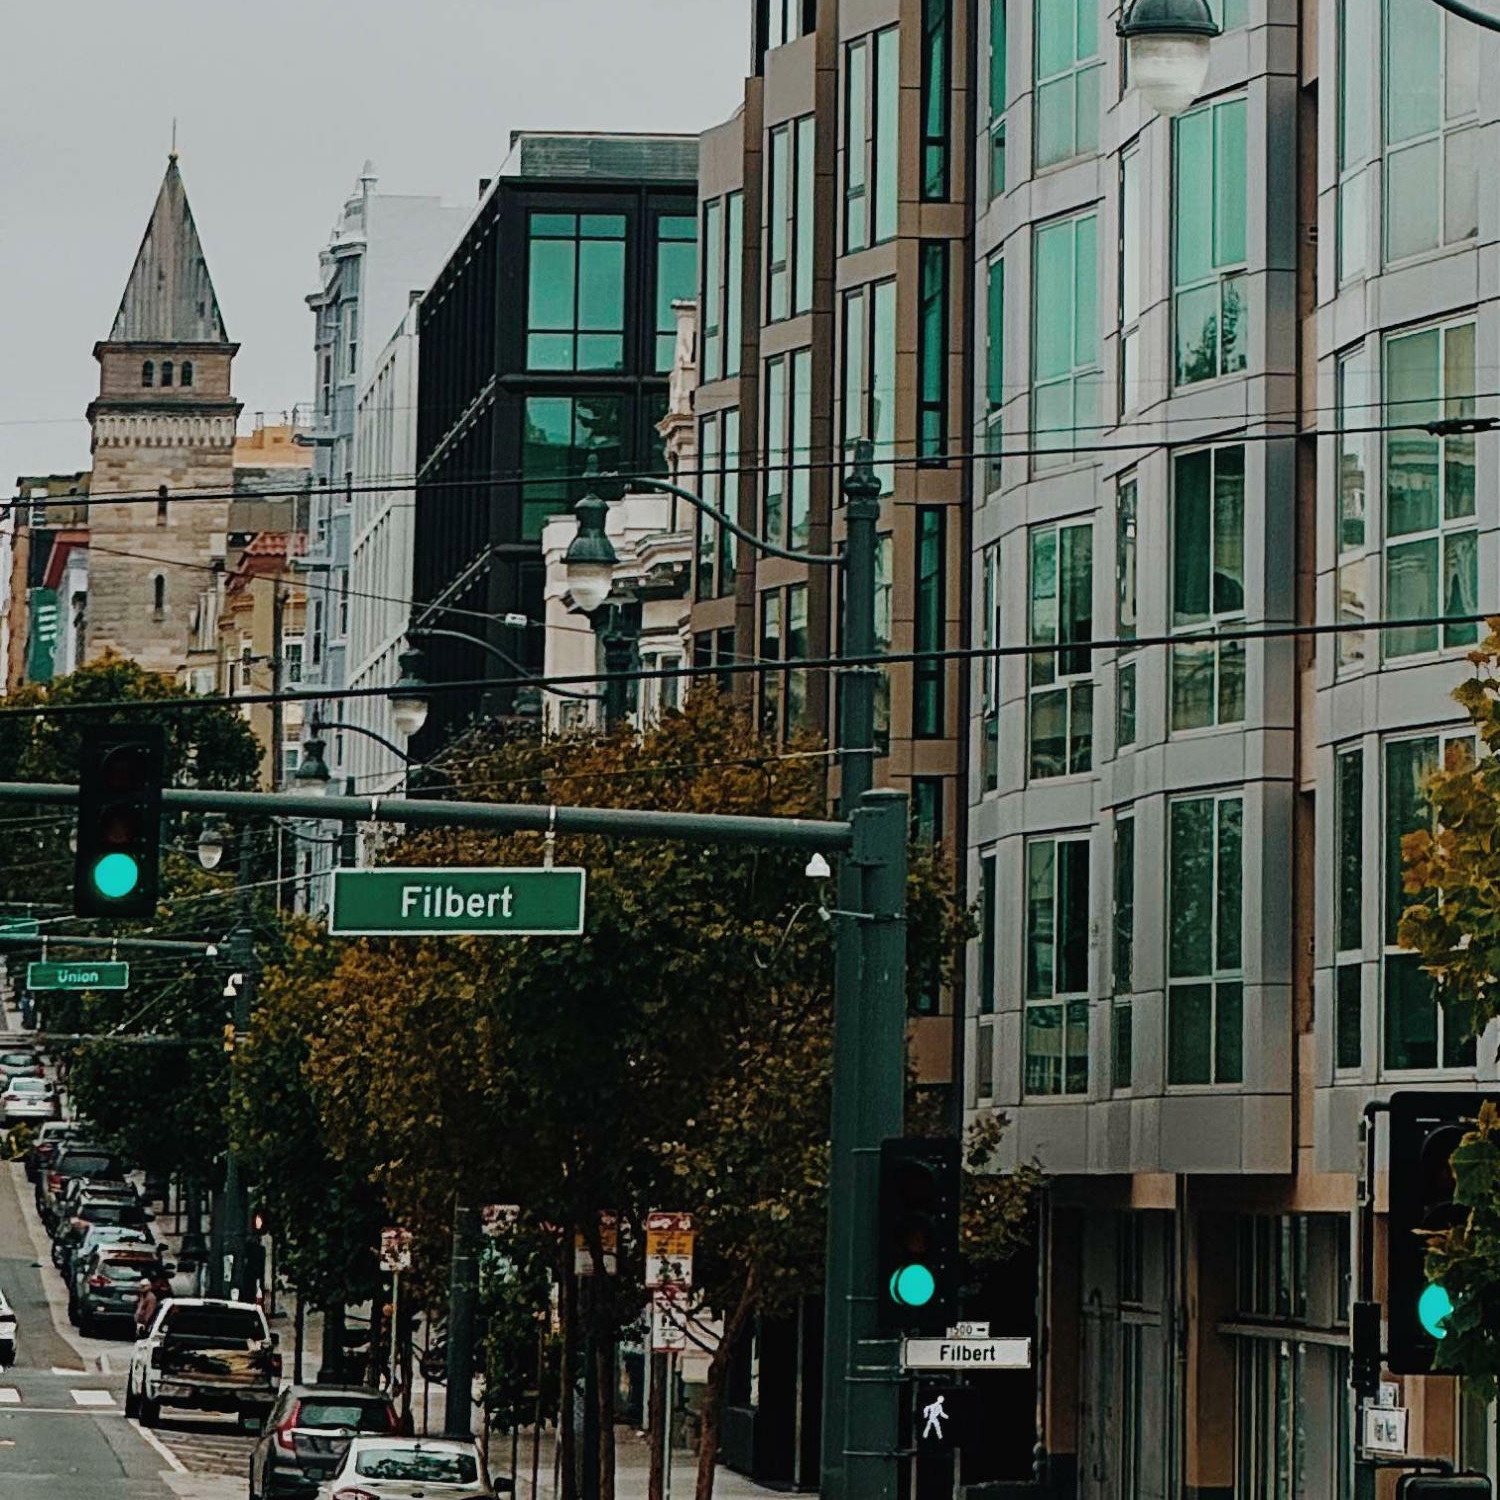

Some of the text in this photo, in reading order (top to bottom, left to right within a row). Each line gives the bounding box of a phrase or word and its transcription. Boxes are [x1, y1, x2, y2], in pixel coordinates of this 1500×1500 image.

[401, 885, 513, 918] Filbert
[57, 969, 99, 983] Union
[940, 1344, 996, 1362] Filbert
